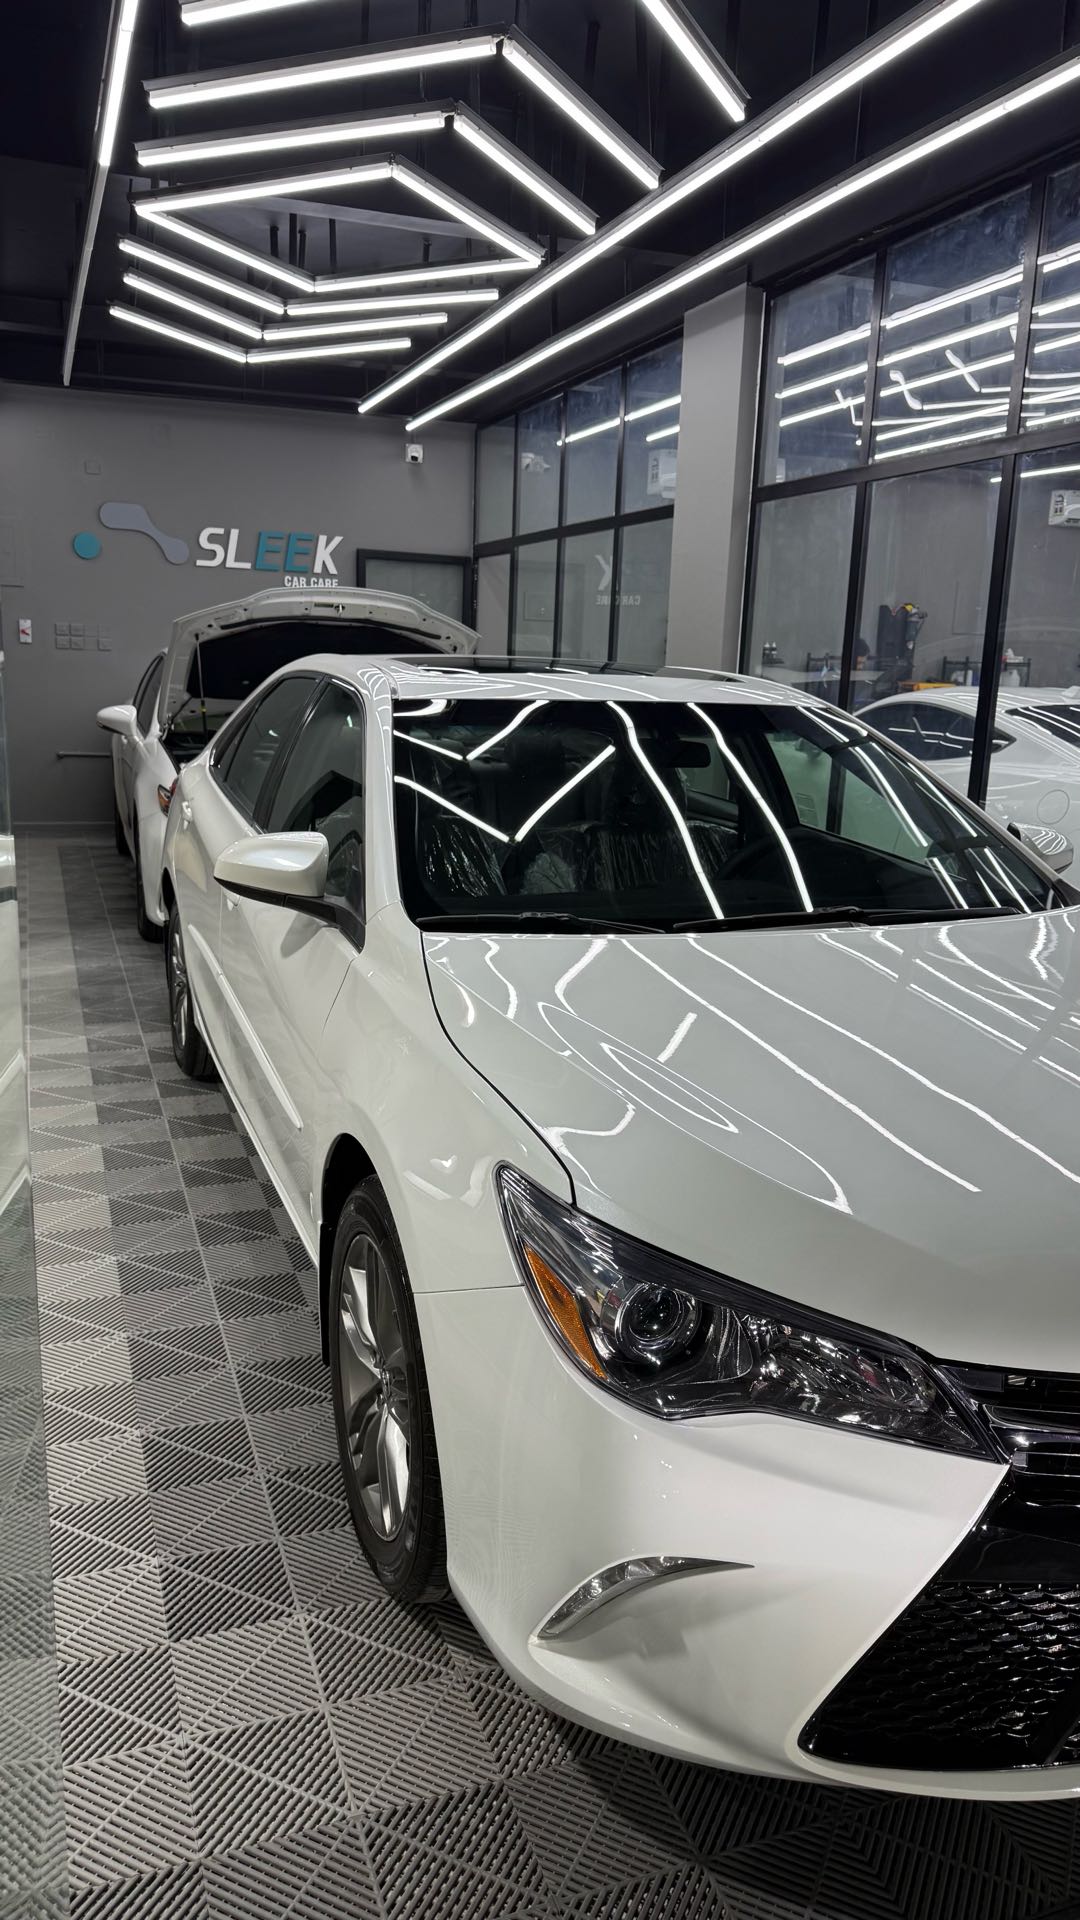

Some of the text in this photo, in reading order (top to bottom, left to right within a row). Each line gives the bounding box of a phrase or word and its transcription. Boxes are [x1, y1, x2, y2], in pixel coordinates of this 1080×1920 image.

[196, 527, 344, 575] SLEEK
[284, 575, 338, 588] CAR CARE
